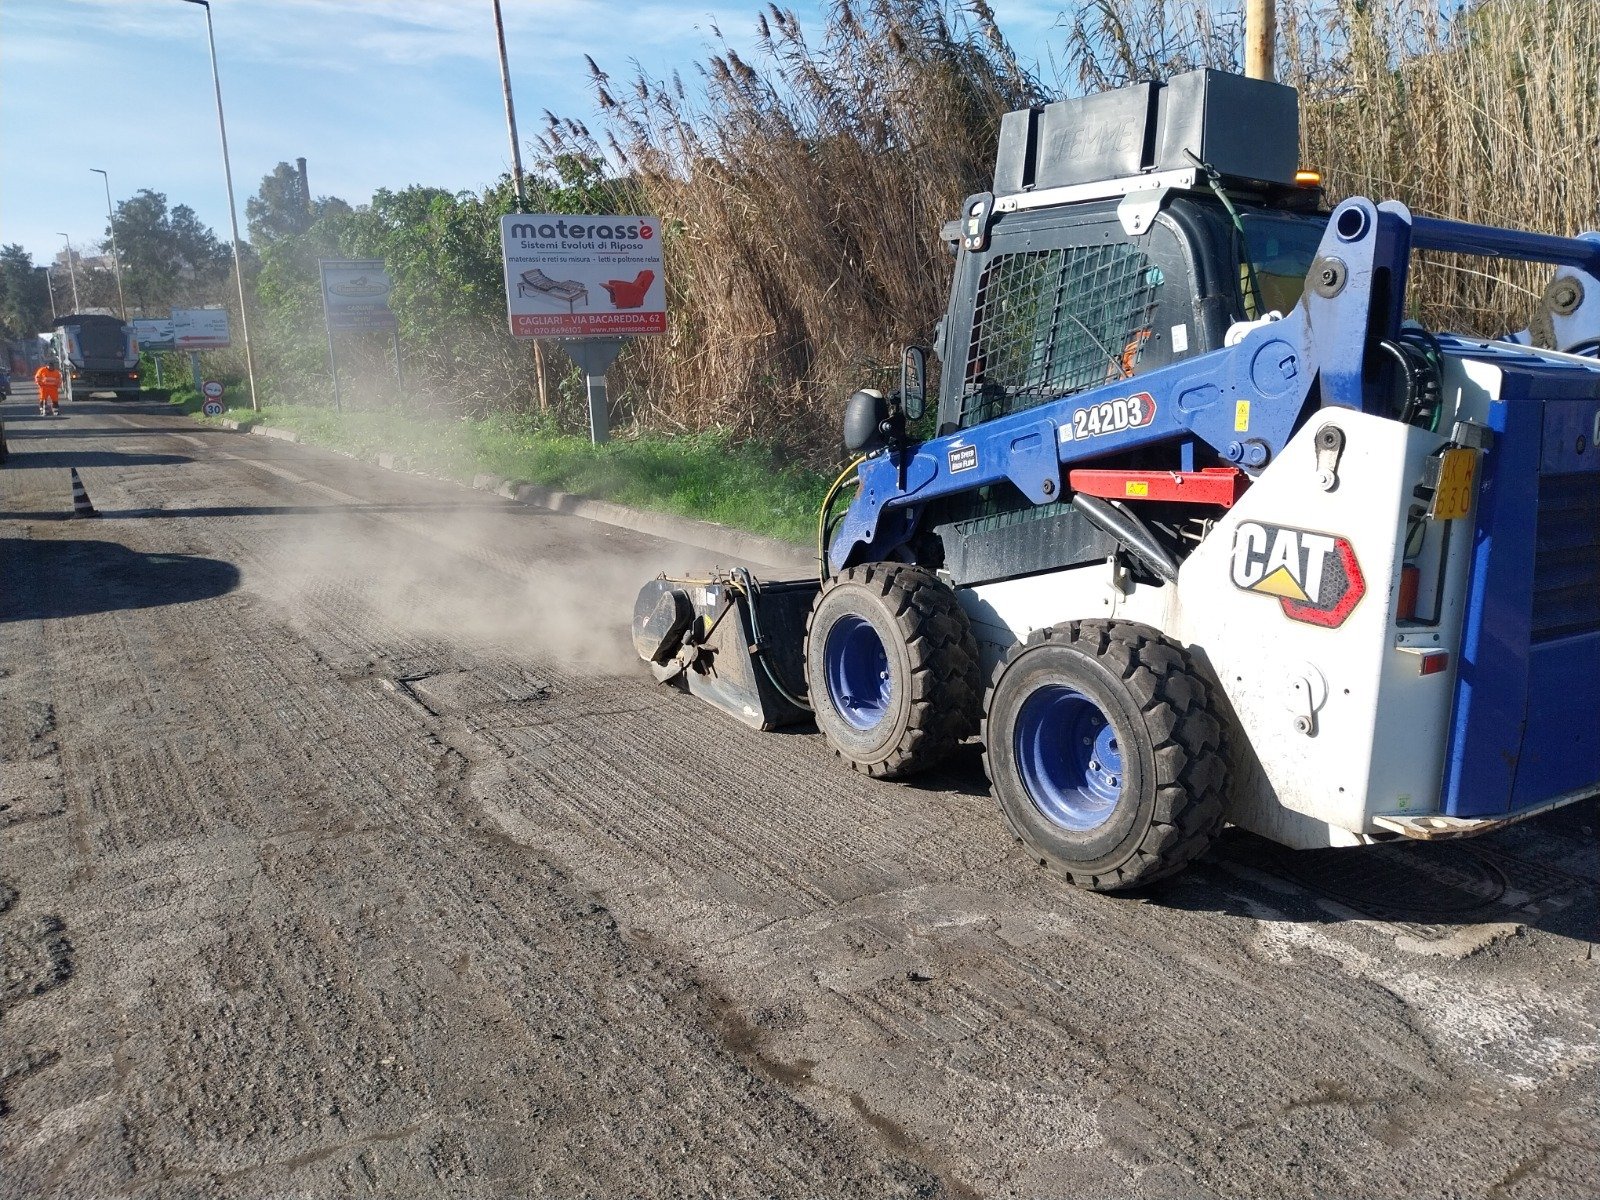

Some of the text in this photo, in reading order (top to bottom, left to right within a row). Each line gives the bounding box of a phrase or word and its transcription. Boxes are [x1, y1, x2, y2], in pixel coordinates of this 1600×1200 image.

[511, 220, 653, 239] materassè
[521, 241, 558, 249] Sistemi
[561, 241, 595, 250] Evoluti
[611, 242, 643, 251] Riposo
[617, 256, 644, 264] poltrone
[519, 317, 563, 325] CAGLIARI
[571, 316, 587, 324] VIA
[589, 315, 648, 323] BACAREDDA,
[649, 314, 660, 322] 62
[208, 405, 220, 414] 30
[1074, 397, 1143, 438] 242D3
[1437, 487, 1470, 514] 630
[1233, 522, 1335, 603] CAT
